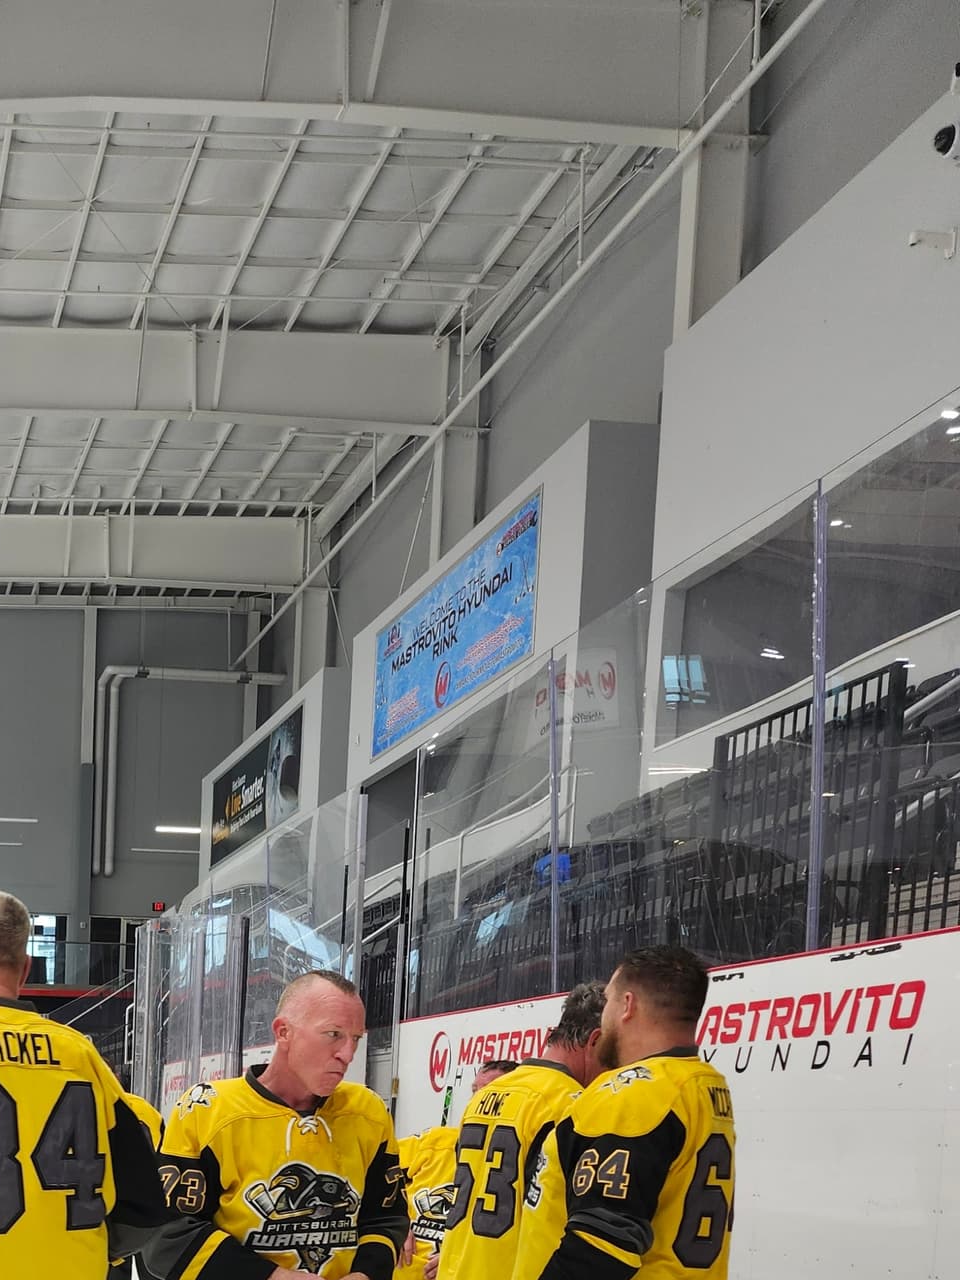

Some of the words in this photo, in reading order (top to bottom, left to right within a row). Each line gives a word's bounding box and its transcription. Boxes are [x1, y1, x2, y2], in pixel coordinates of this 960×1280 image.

[391, 609, 456, 675] MASTROVITO
[457, 562, 513, 622] HYUNDAI
[412, 598, 454, 640] WELCOME
[455, 586, 467, 601] TO
[468, 567, 486, 587] THE
[432, 626, 458, 661] RINK
[695, 980, 926, 1046] ASTROVITO
[702, 1033, 914, 1074] YUNDAI
[157, 1164, 208, 1215] 73
[445, 1123, 522, 1240] 53
[572, 1149, 631, 1200] 64
[266, 1219, 350, 1232] PITTSBURGH
[672, 1133, 736, 1270] 6
[251, 1229, 357, 1248] WARRIORS
